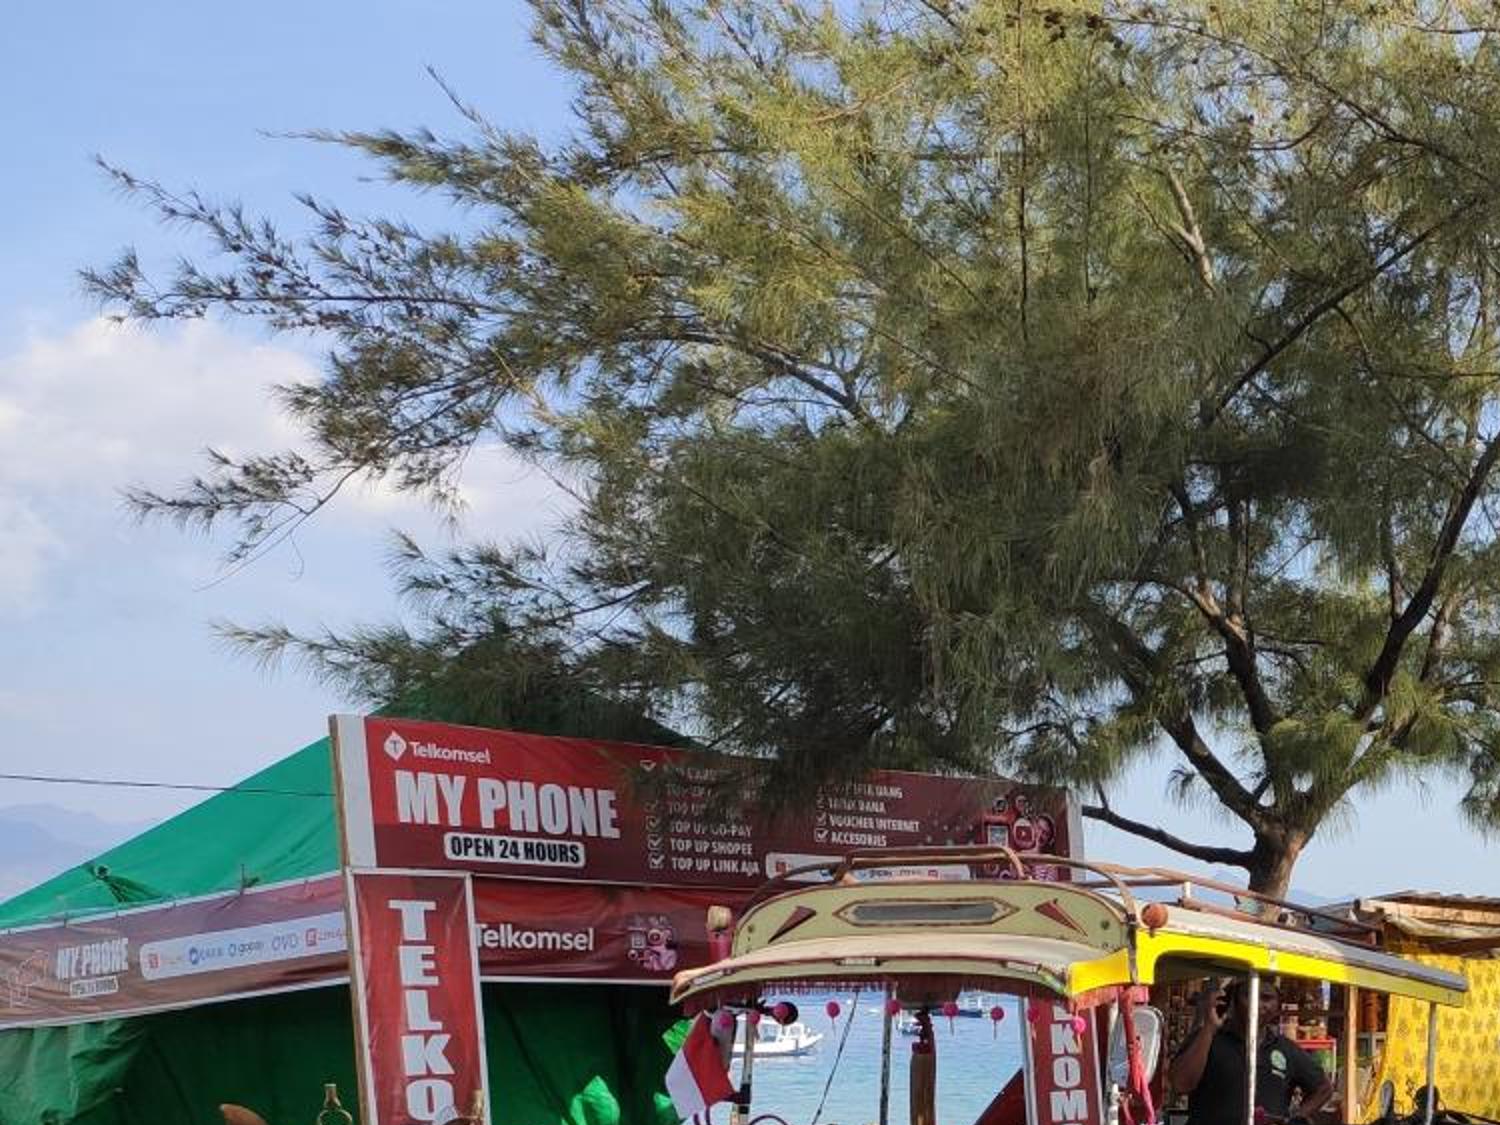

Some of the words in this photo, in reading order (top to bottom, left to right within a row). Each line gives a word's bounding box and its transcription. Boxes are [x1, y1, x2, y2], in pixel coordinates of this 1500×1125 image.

[409, 741, 491, 764] Telkomsel
[395, 769, 466, 826] MY
[478, 777, 620, 838] PHONE
[829, 814, 874, 828] VOUCHER
[876, 818, 920, 832] INTERNET
[450, 837, 494, 858] OPEN
[500, 839, 520, 860] 24
[524, 842, 580, 864] HOURS
[671, 838, 692, 852] TOP
[694, 839, 710, 853] UP
[712, 841, 753, 855] SHOPEE
[672, 857, 693, 870] TOP
[695, 858, 710, 871] UP
